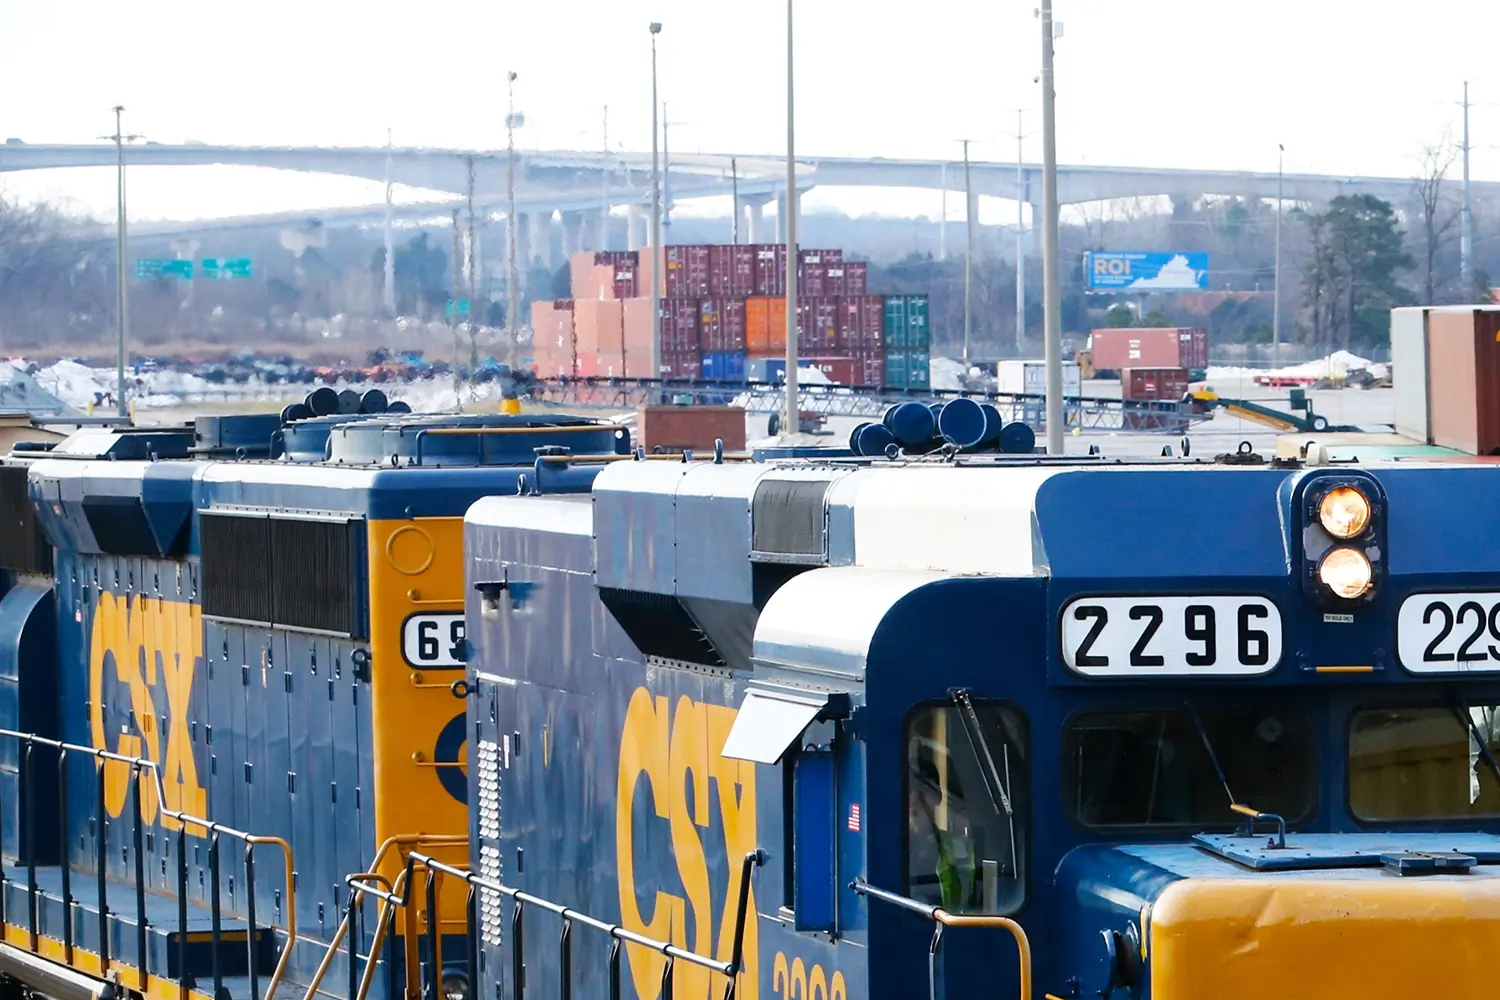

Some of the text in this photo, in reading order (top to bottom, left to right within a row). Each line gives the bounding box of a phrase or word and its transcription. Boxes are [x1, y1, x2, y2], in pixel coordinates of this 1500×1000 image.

[1095, 259, 1131, 275] ROI
[1074, 604, 1269, 667] 2296
[89, 591, 208, 838] CSX
